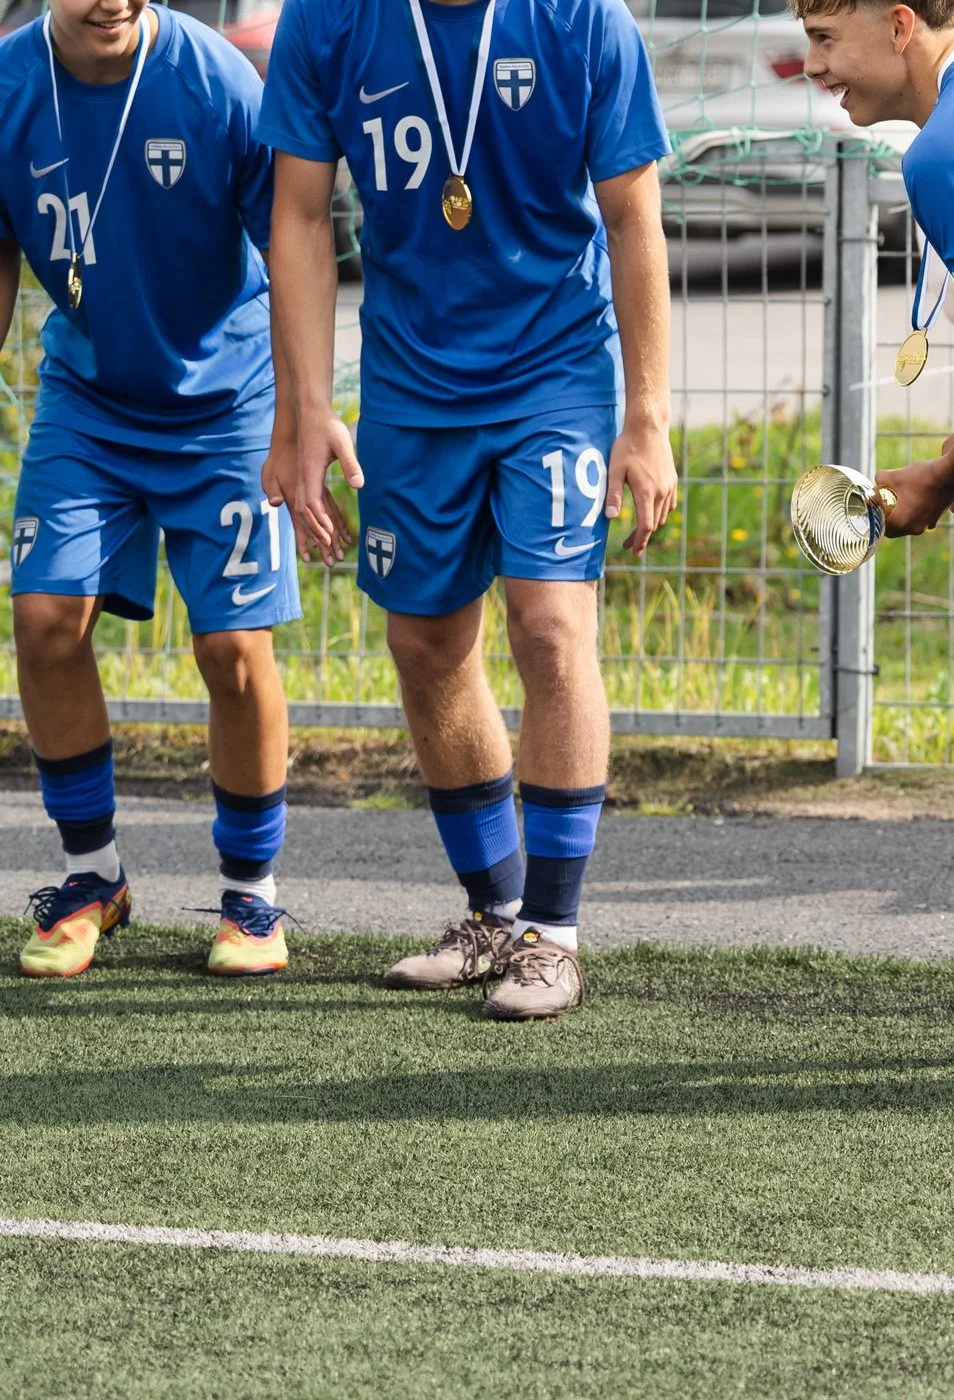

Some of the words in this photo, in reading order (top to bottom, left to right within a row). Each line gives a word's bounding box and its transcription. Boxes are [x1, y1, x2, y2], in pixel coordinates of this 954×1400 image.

[362, 114, 433, 192] 19
[37, 191, 97, 266] 21
[541, 447, 608, 528] 19
[219, 498, 281, 578] 21
